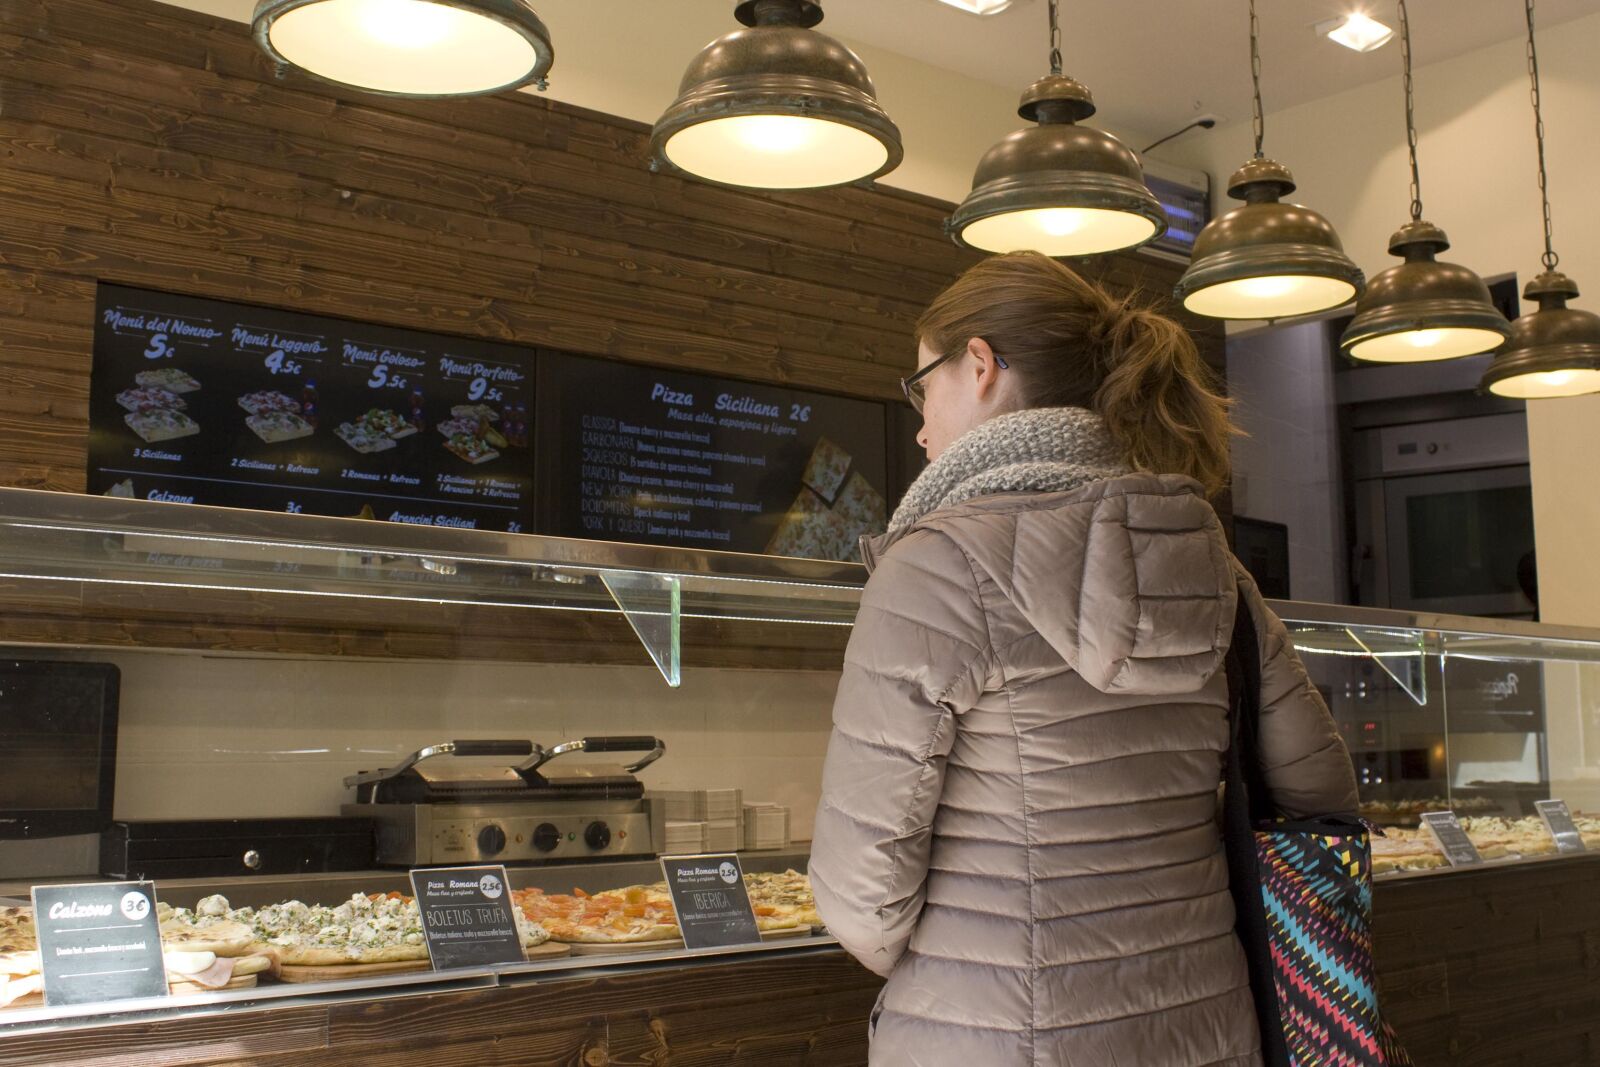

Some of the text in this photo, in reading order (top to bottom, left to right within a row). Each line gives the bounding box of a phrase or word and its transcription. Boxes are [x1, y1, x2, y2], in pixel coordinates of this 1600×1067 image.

[104, 308, 222, 338] Menú del Nonno
[231, 327, 268, 348] Menú
[343, 344, 425, 367] Menú Goloso
[440, 358, 525, 381] Menú Perfetto
[651, 383, 811, 423] Pizza Siciliana 2€
[667, 408, 694, 421] Masa
[719, 417, 762, 433] esponjosa
[763, 422, 770, 434] y
[771, 422, 797, 436] ligera
[133, 448, 182, 461] 3 Sicilianas
[231, 458, 238, 467] 2
[238, 459, 276, 471] Sicilianas
[341, 469, 347, 478] 2
[348, 470, 380, 481] Romanas
[390, 473, 420, 485] Refresco
[147, 489, 194, 504] Calzone
[389, 511, 433, 525] Arancini
[433, 515, 476, 529] Siciliani
[695, 867, 718, 876] Romana
[428, 879, 478, 889] Pizza Romana
[482, 882, 500, 891] 2.5€
[126, 900, 146, 912] 3€
[694, 892, 730, 910] IBERICA
[49, 902, 112, 919] Calzone
[426, 907, 508, 926] BOLETUS TRUFA
